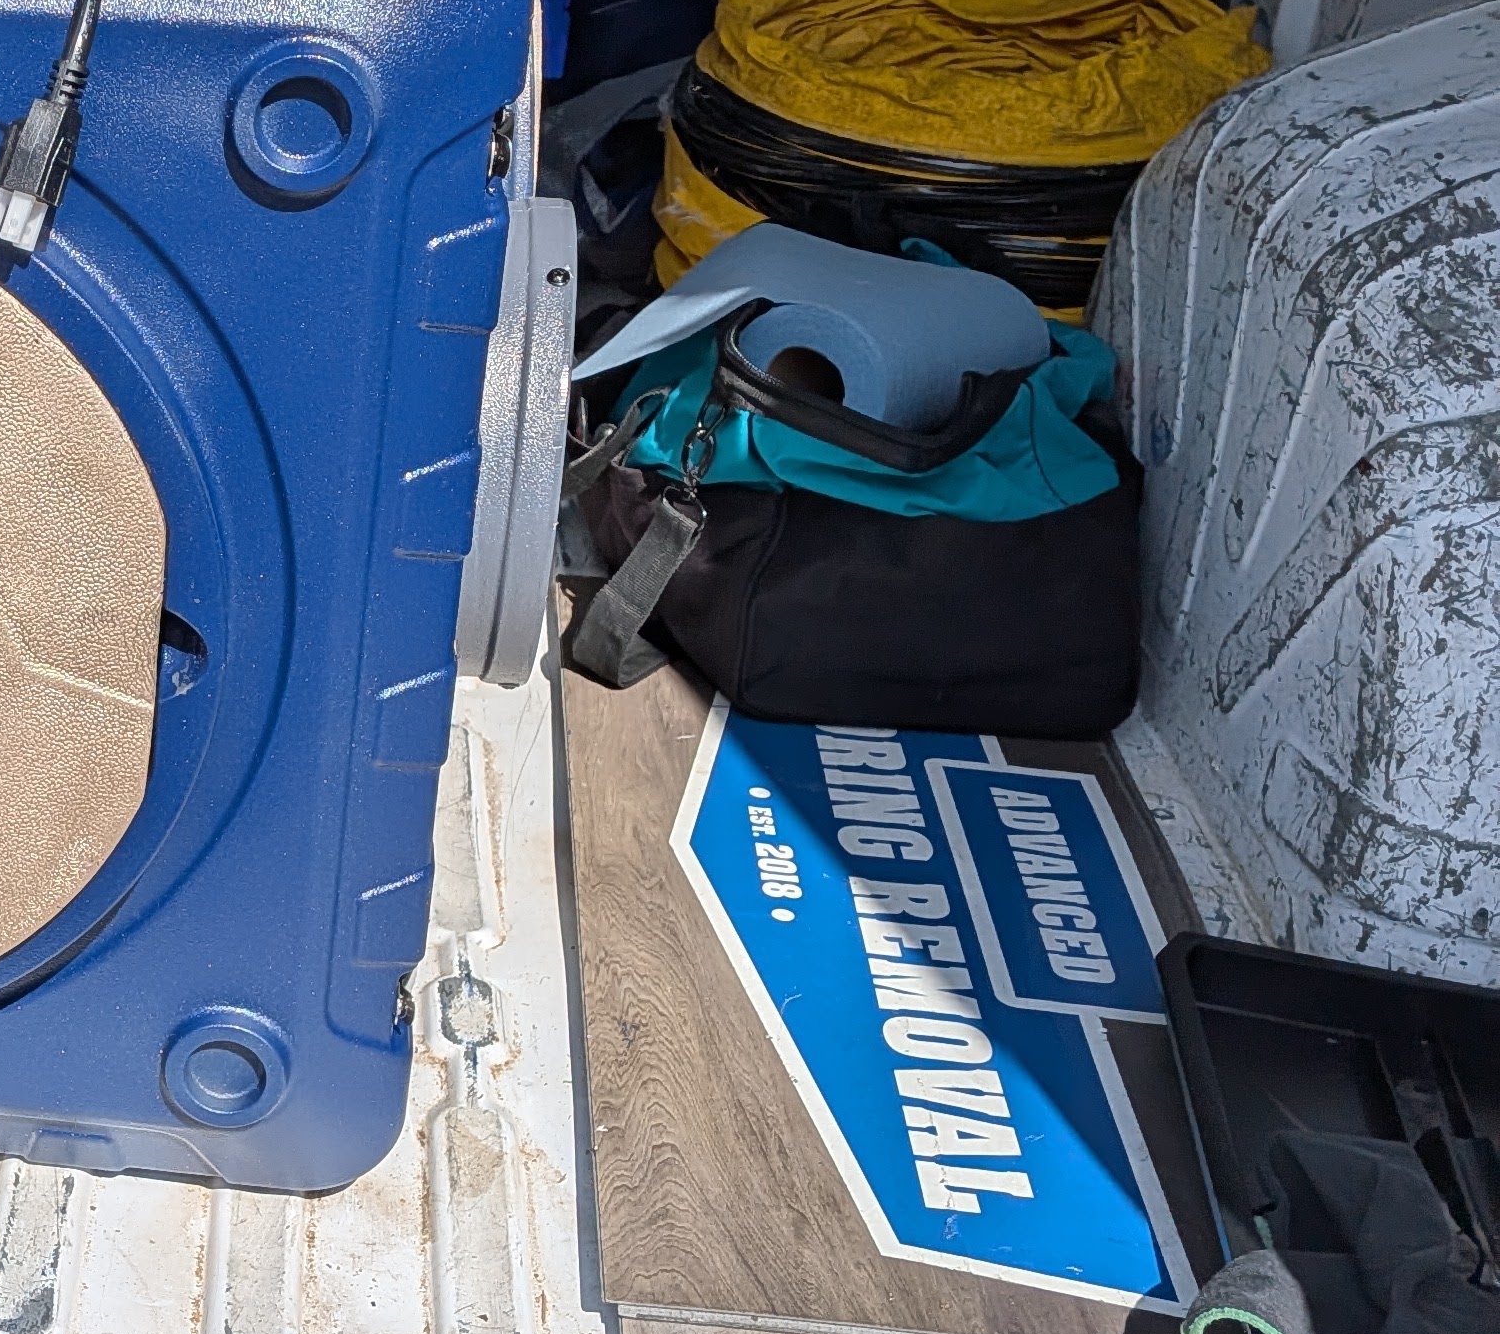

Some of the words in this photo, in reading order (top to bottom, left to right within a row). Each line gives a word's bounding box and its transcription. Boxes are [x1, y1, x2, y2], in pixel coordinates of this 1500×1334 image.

[747, 803, 776, 837] EST.
[755, 839, 803, 902] 2018
[989, 785, 1116, 984] ADVANCED
[849, 874, 1035, 1214] REMOVAL
